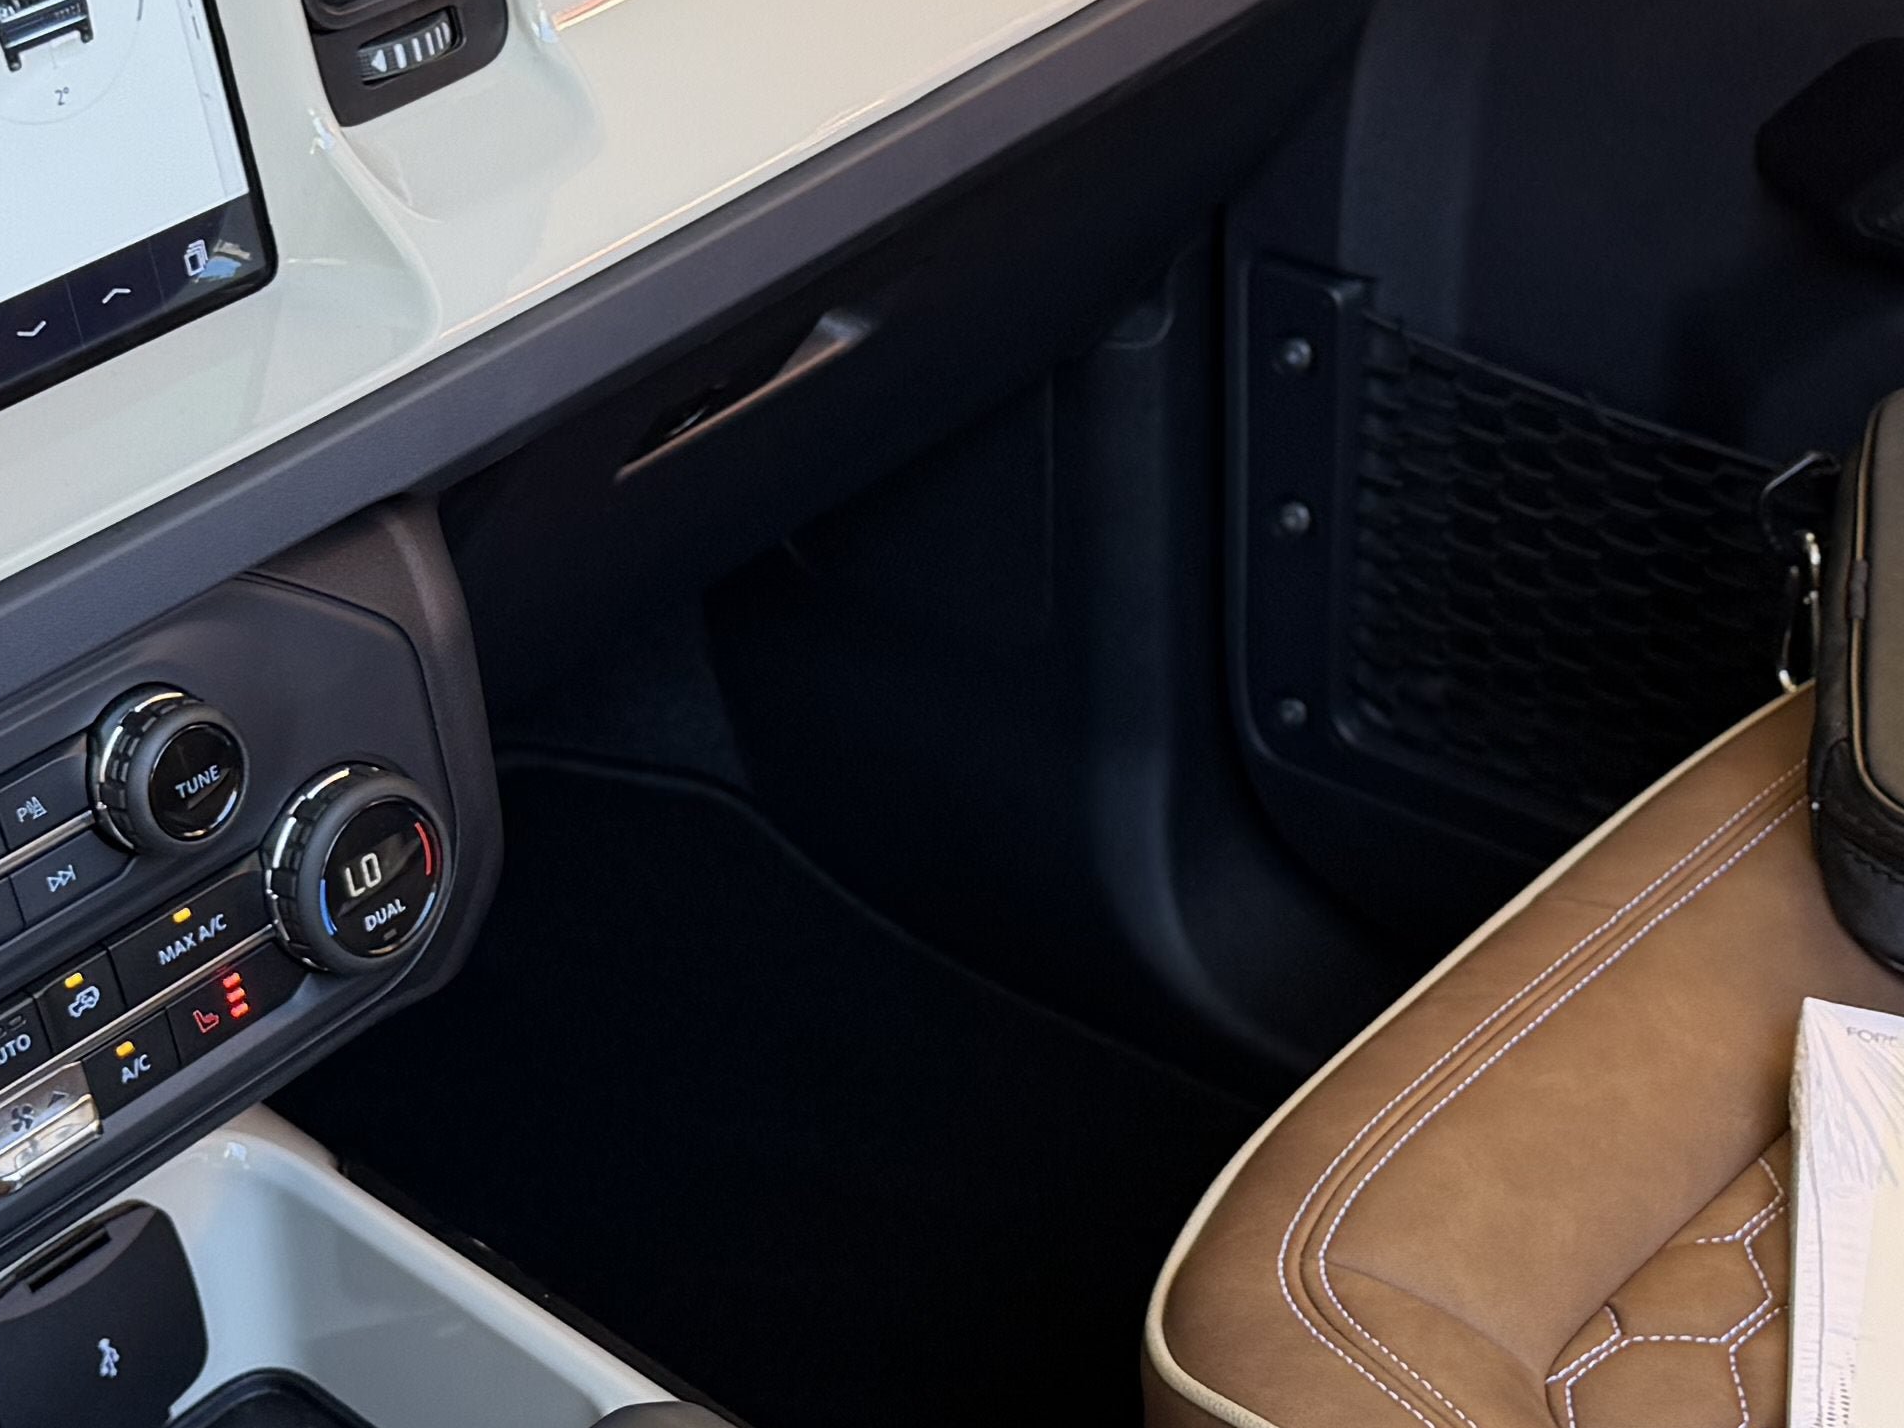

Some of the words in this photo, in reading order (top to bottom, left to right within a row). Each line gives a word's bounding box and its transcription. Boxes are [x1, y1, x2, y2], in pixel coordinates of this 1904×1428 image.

[54, 86, 70, 106] 2°
[175, 764, 221, 800] TUNE
[343, 852, 383, 899] LO
[363, 898, 407, 933] DUAL
[158, 932, 197, 966] MAX
[197, 912, 228, 947] A/C
[120, 1053, 153, 1084] A/C
